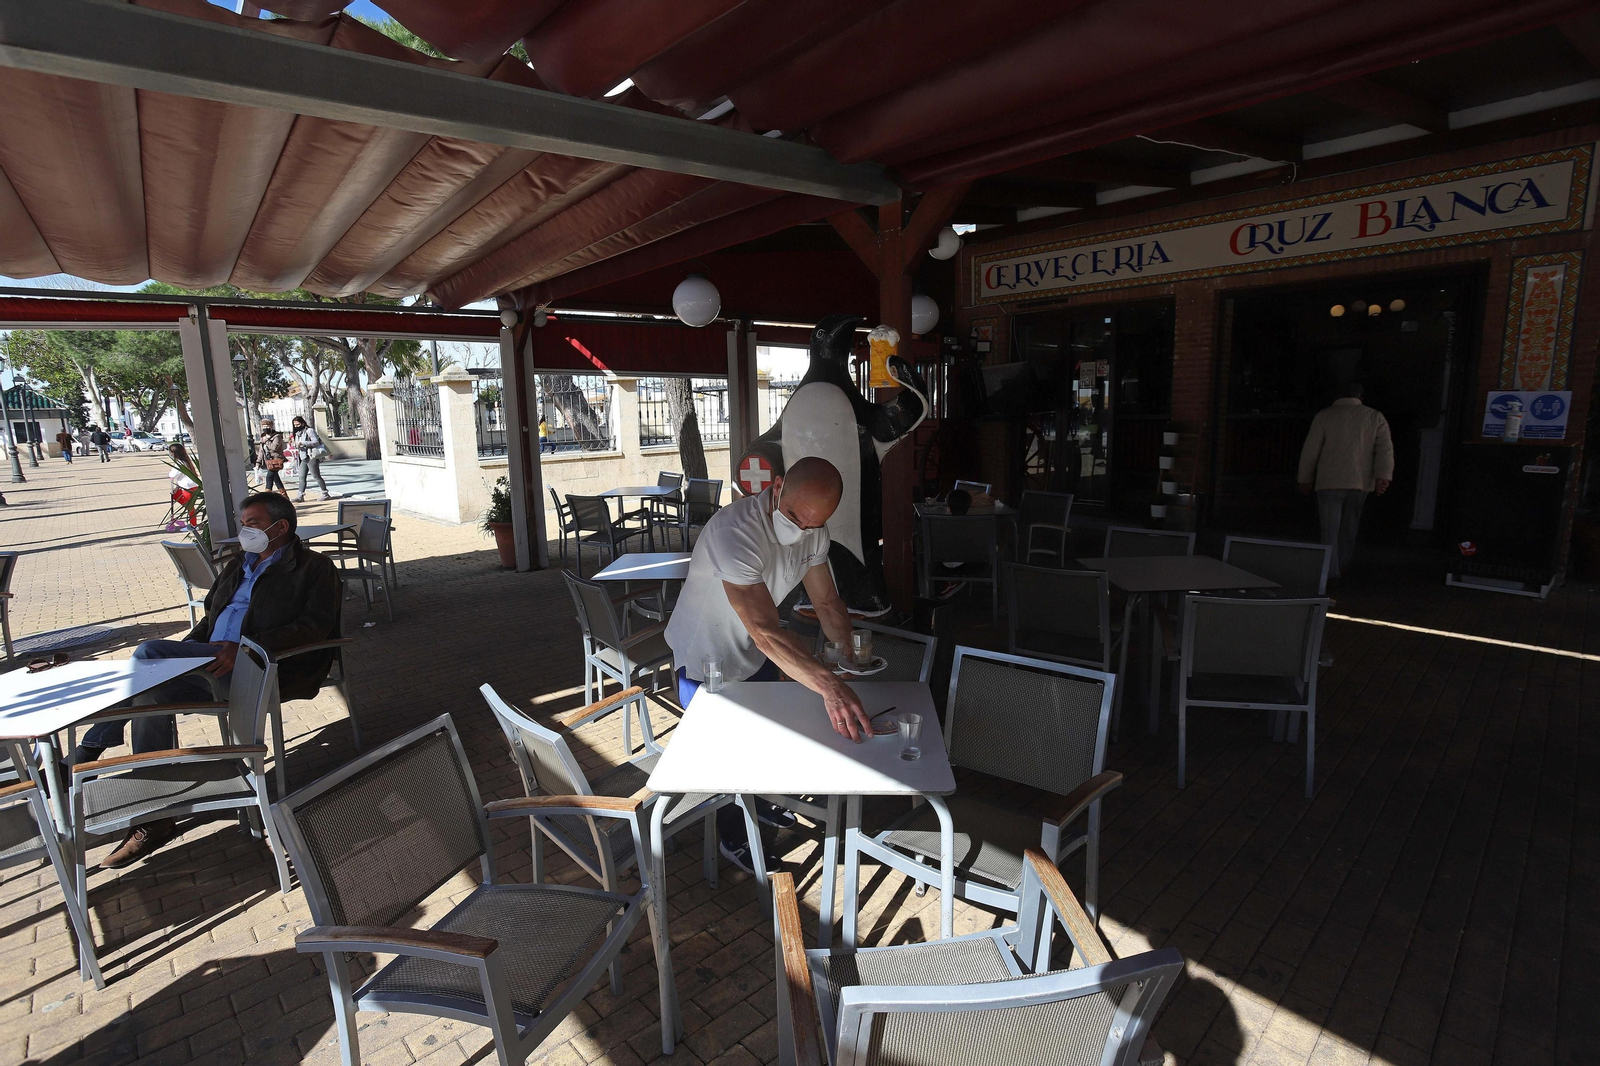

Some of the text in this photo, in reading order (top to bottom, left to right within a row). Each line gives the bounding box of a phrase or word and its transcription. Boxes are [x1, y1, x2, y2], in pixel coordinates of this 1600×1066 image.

[985, 177, 1554, 289] CERVECERIA CRUZ BLANCA
